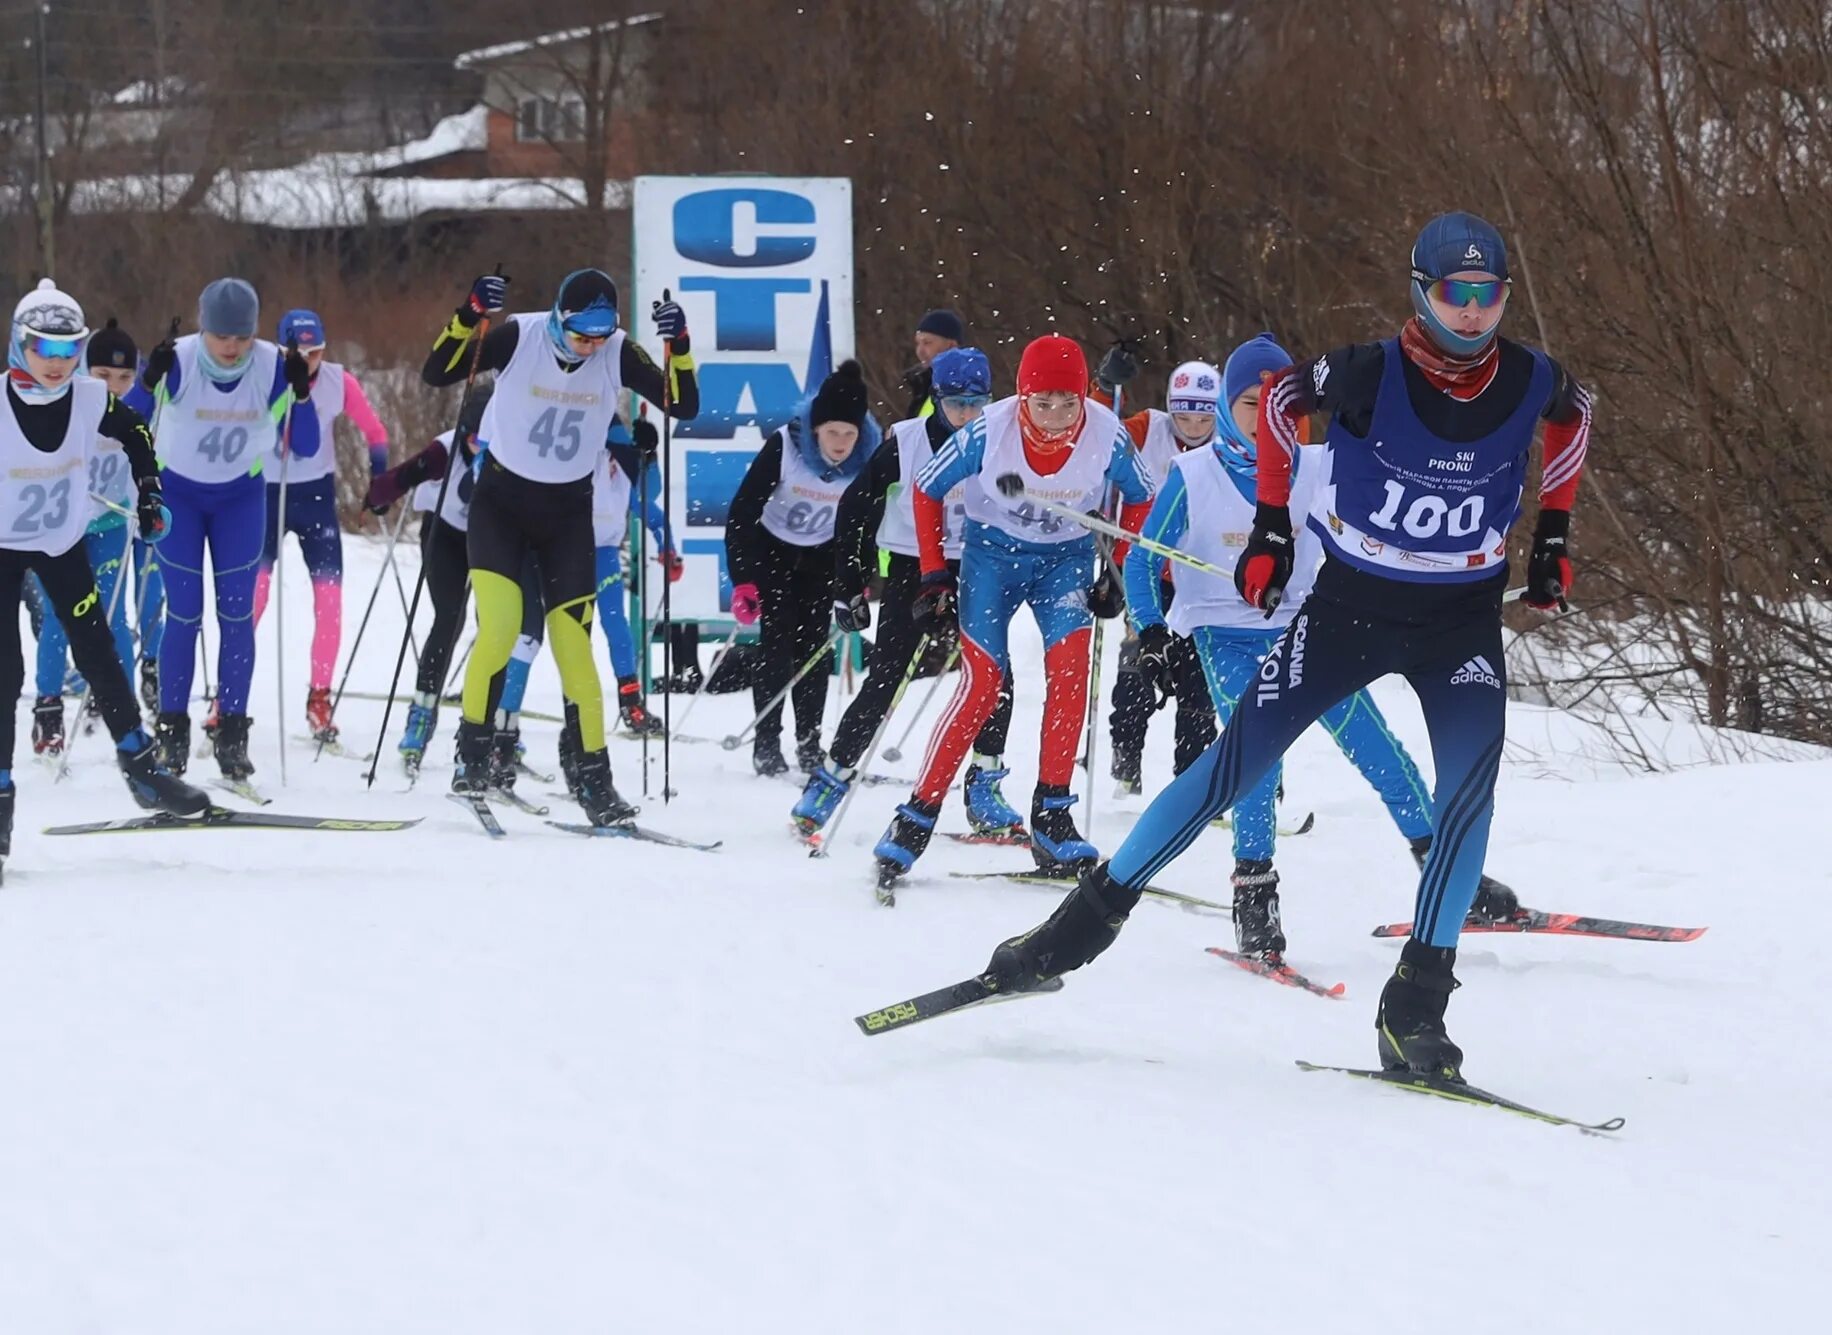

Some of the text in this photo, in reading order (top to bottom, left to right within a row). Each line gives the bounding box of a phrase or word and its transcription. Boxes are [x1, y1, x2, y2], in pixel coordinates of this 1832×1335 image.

[197, 426, 248, 463] 40
[528, 406, 586, 462] 45
[1428, 458, 1472, 472] PROKU
[1455, 451, 1475, 462] SKI
[11, 478, 71, 533] 23
[786, 501, 833, 535] 60
[1368, 479, 1485, 539] 100
[1288, 614, 1309, 690] SCANIA
[1450, 670, 1501, 689] adidas
